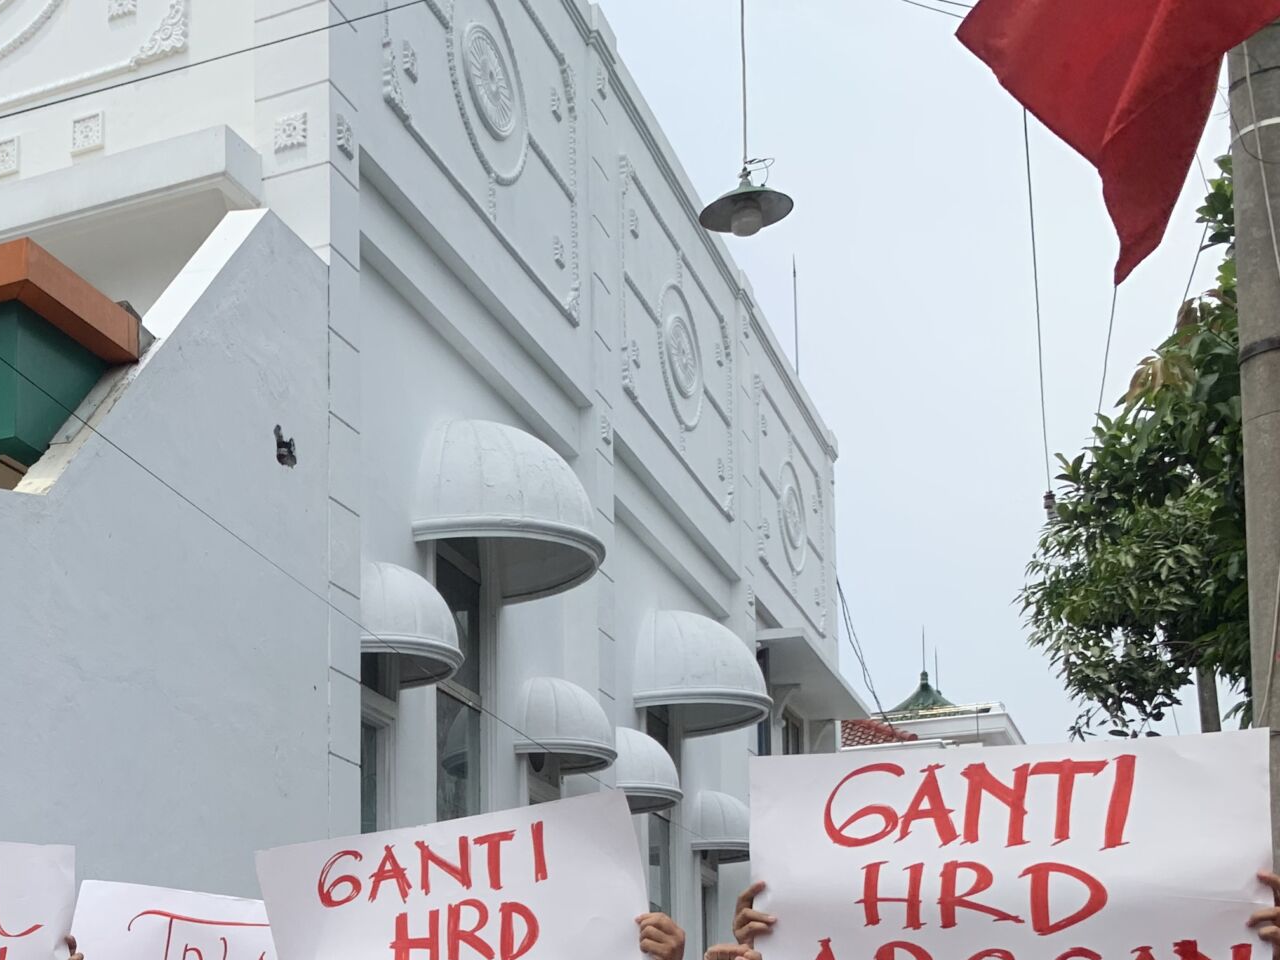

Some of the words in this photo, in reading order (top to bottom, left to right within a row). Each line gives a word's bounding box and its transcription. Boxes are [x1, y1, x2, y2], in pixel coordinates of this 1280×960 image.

[823, 754, 1136, 850] GANTI
[317, 821, 548, 908] GANTI
[854, 860, 1108, 935] HRD
